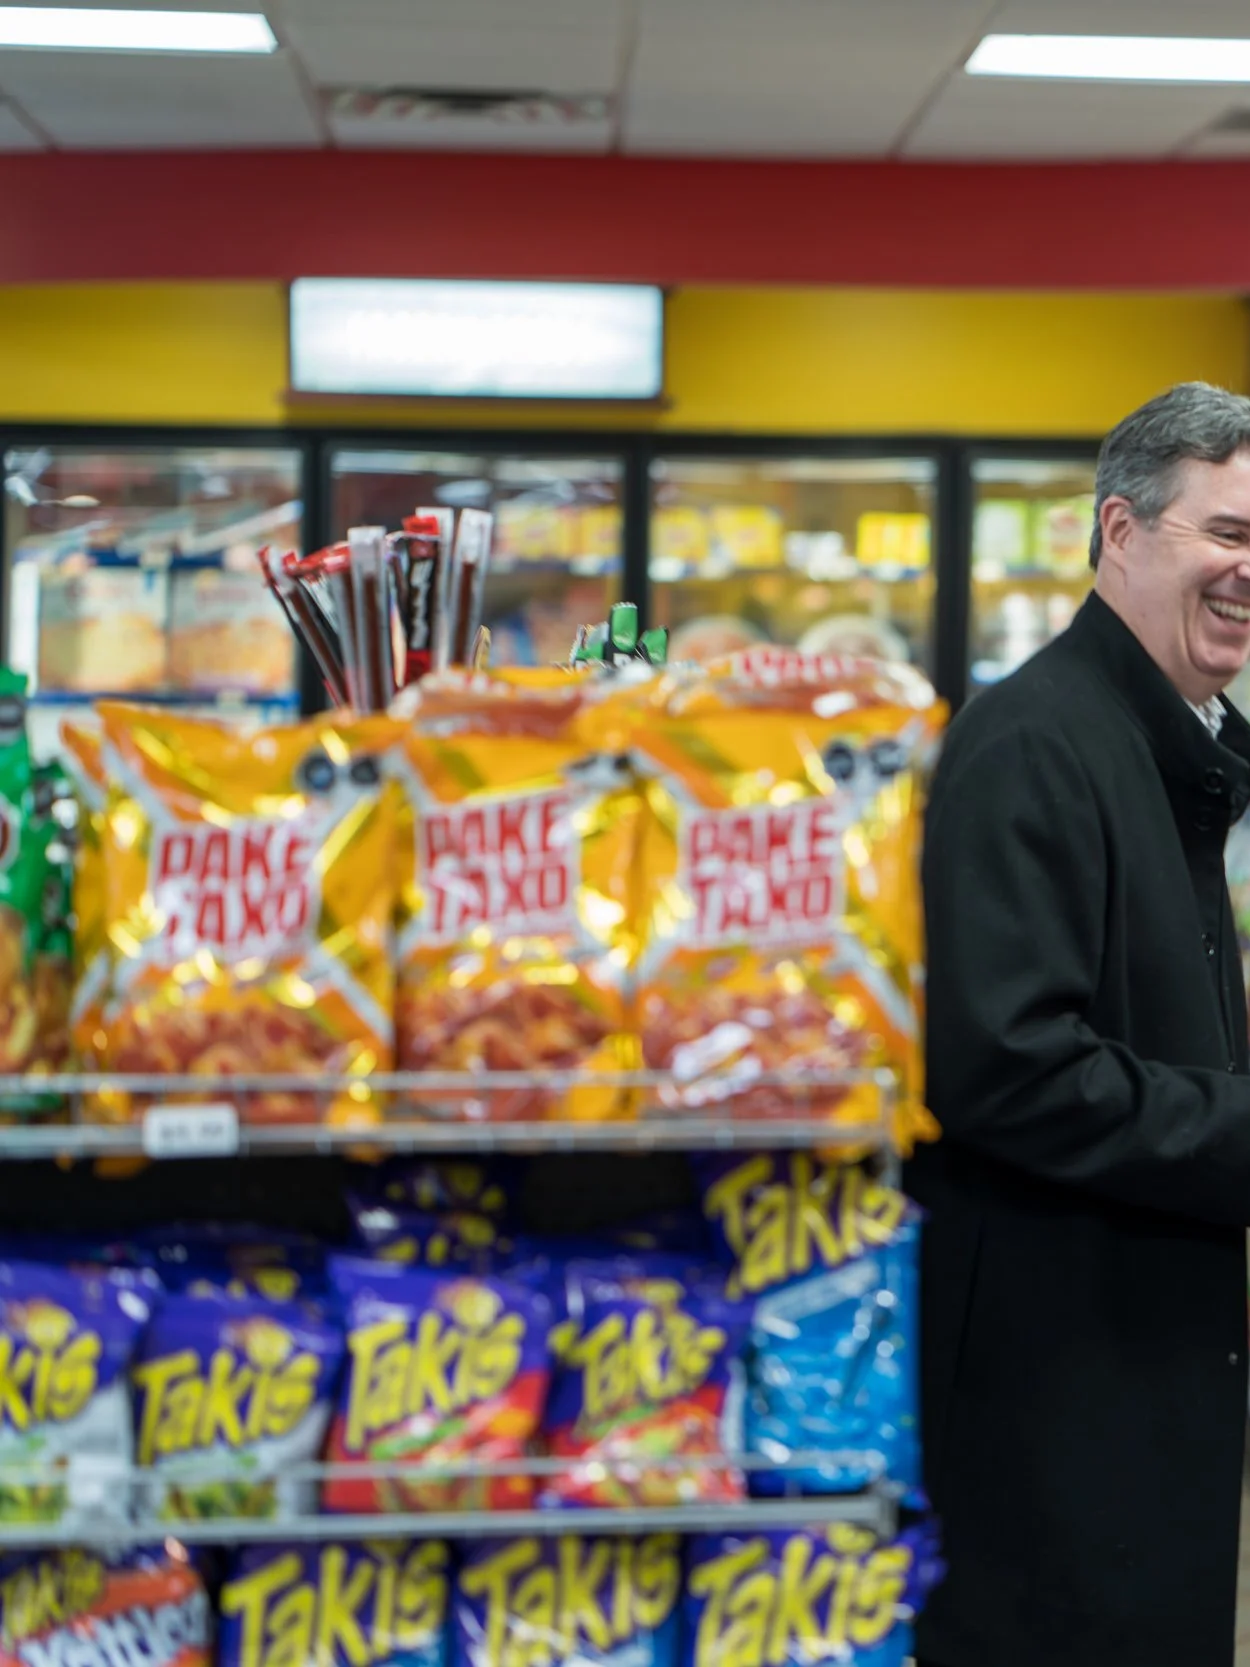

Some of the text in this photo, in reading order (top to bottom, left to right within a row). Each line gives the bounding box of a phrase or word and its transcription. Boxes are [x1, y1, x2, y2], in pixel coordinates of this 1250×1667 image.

[163, 886, 310, 946] AXO
[132, 1346, 321, 1468] Takis
[345, 1311, 526, 1450] Takis
[690, 1536, 911, 1667] Takis
